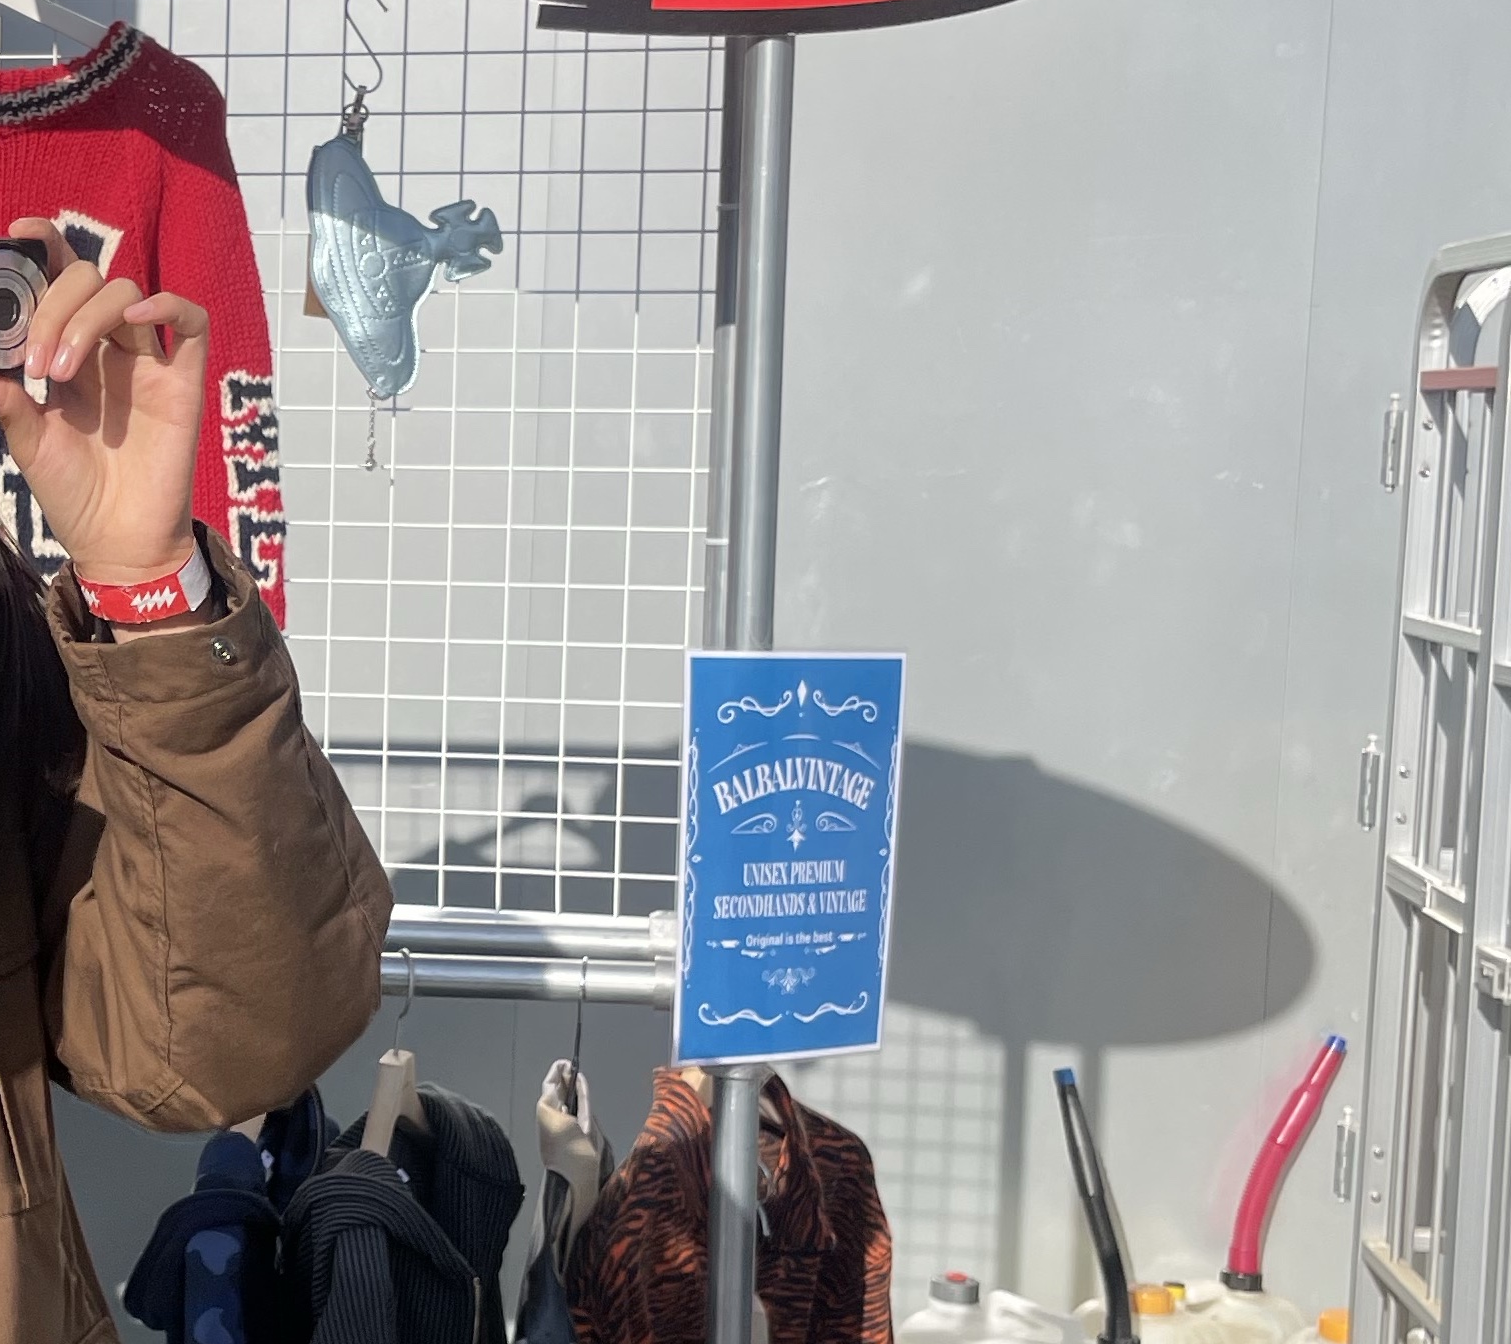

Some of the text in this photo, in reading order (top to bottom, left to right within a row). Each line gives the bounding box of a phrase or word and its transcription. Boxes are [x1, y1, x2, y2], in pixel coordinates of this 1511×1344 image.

[712, 757, 875, 816] BALBALVINTAGE
[742, 859, 846, 887] UNISEX PREMIUM
[713, 889, 867, 920] SECONDHANDS & VINTAGE
[745, 930, 833, 948] Original is the best
